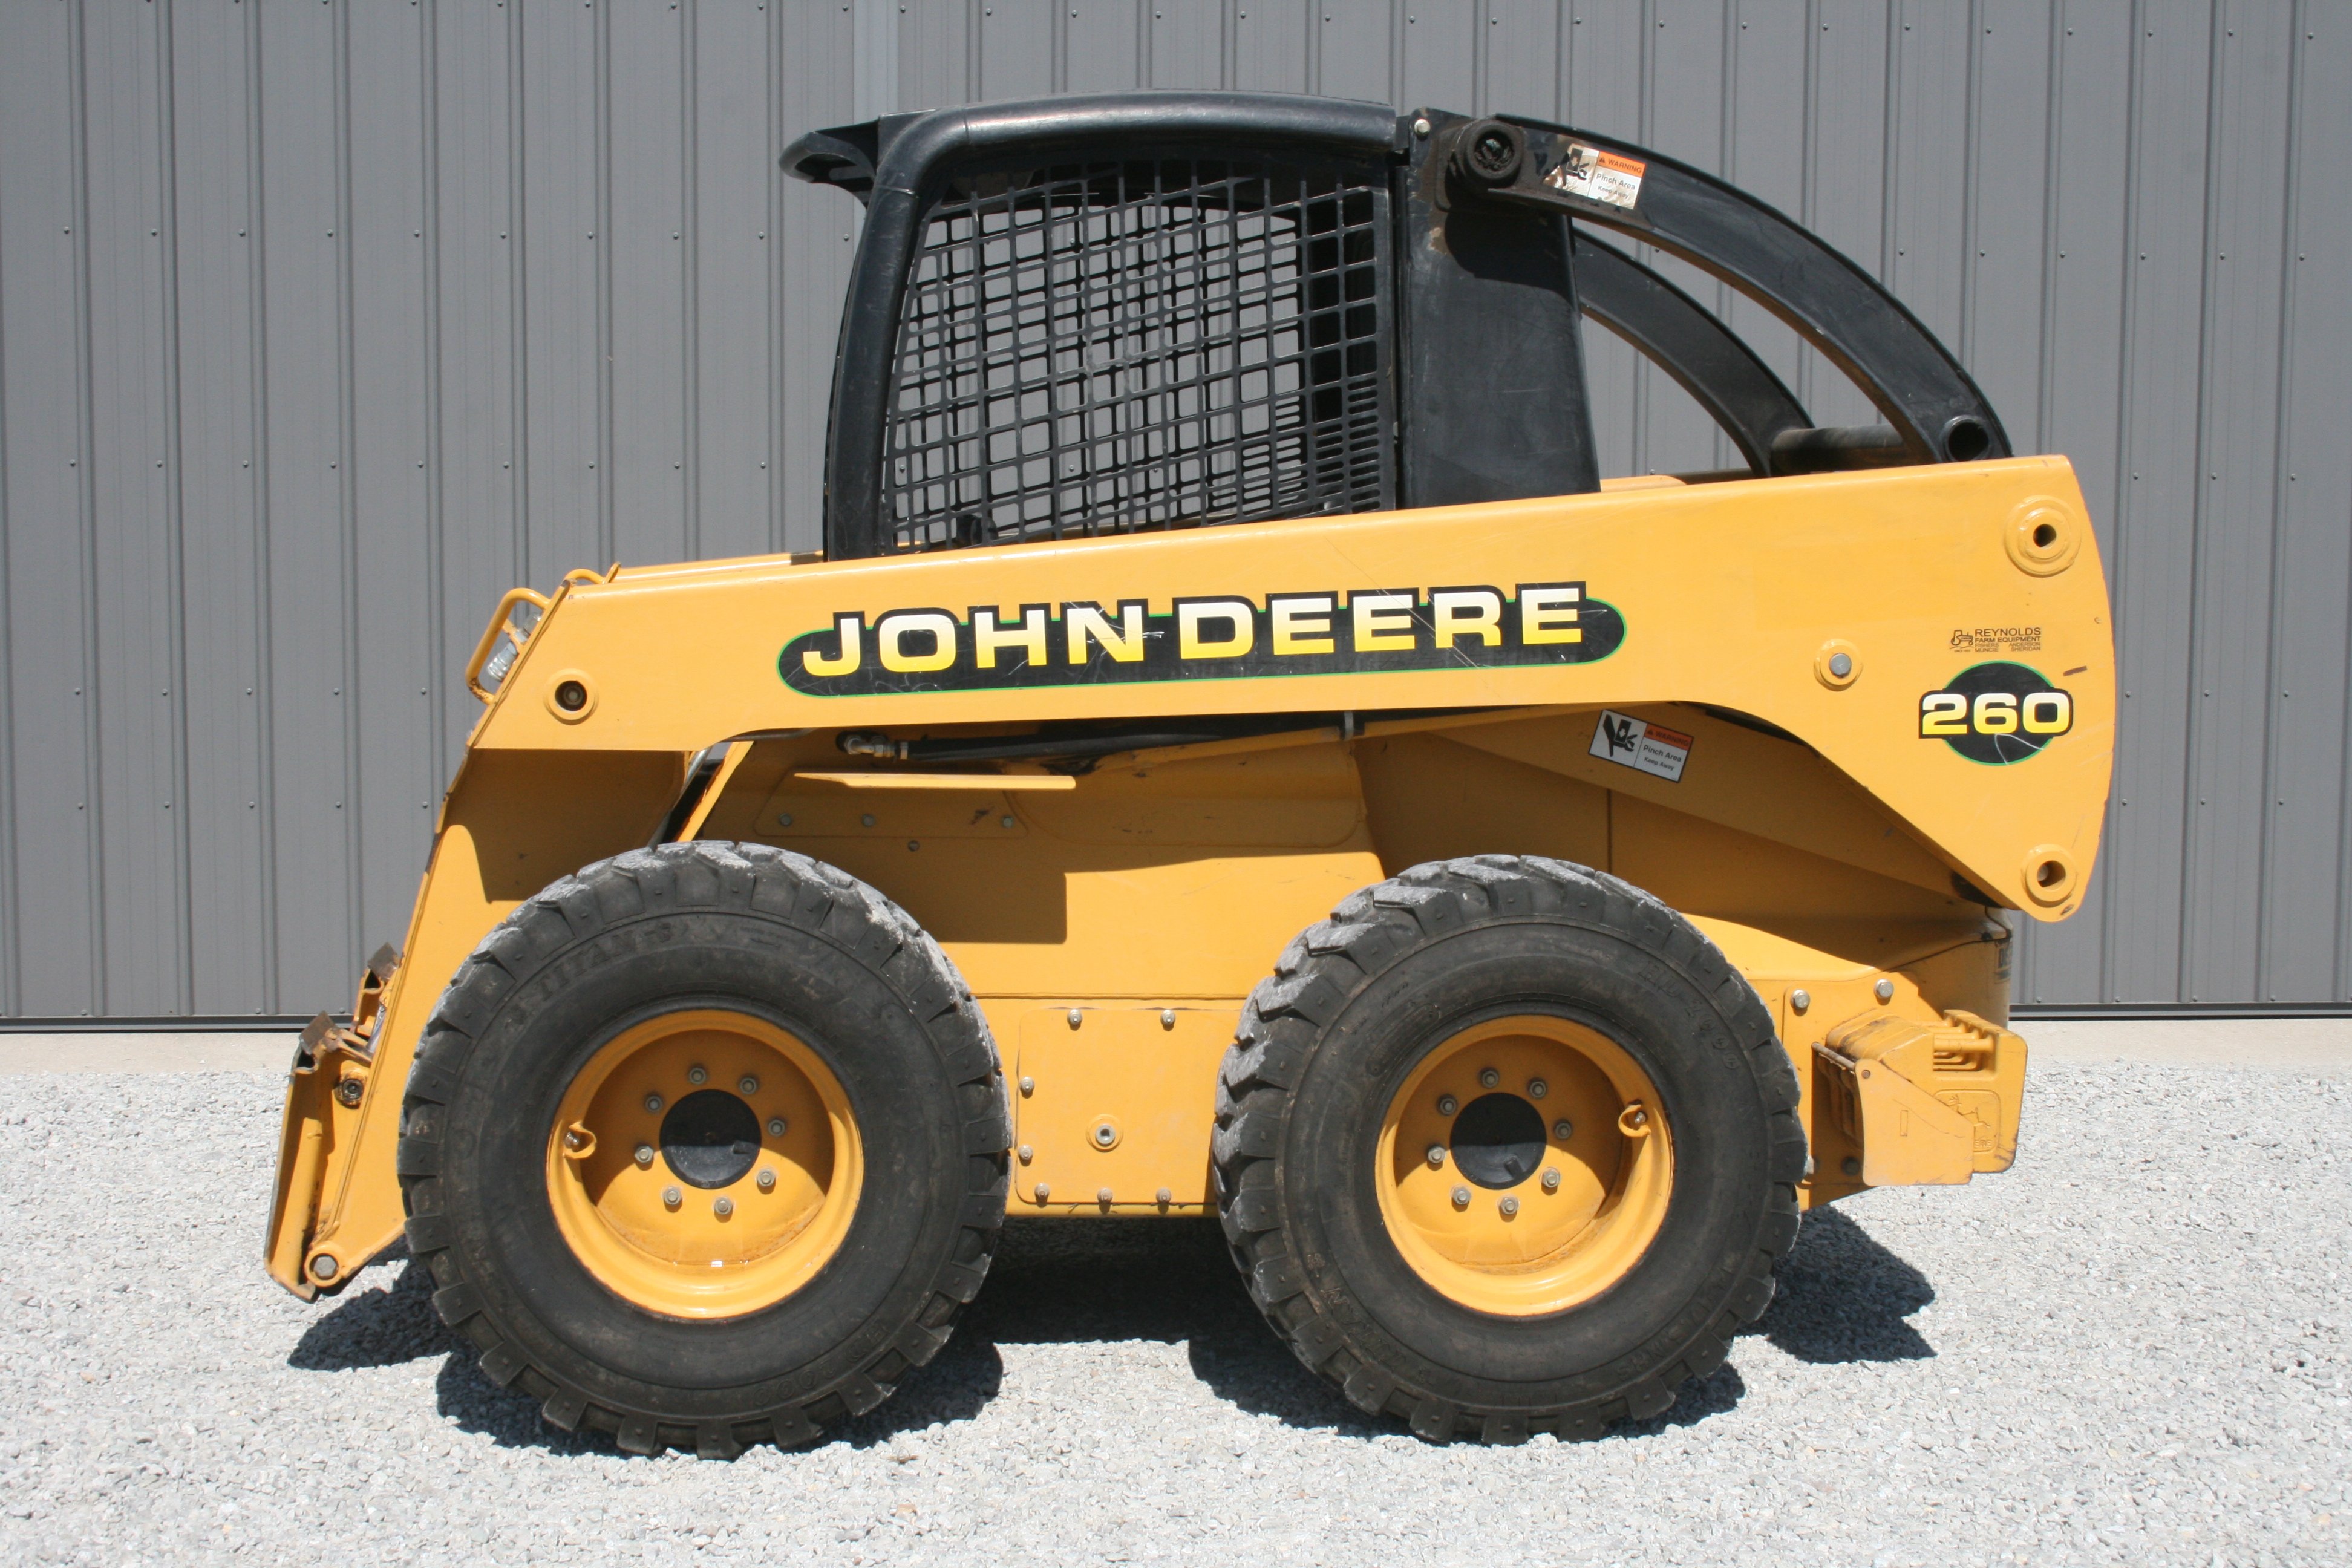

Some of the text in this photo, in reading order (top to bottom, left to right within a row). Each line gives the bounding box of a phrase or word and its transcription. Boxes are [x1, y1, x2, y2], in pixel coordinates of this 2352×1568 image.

[1608, 158, 1642, 174] WARNING
[1596, 173, 1635, 190] Pinch Area
[1598, 185, 1629, 200] Keep Away
[803, 587, 1582, 676] JOHN DEERE
[1975, 627, 2041, 636] REYNOLDS
[1922, 691, 2070, 735] 260
[1656, 731, 1688, 746] WARNING
[1643, 745, 1681, 762] Pinch Area
[1644, 757, 1674, 771] Keep Away
[534, 929, 636, 1002] TITAN
